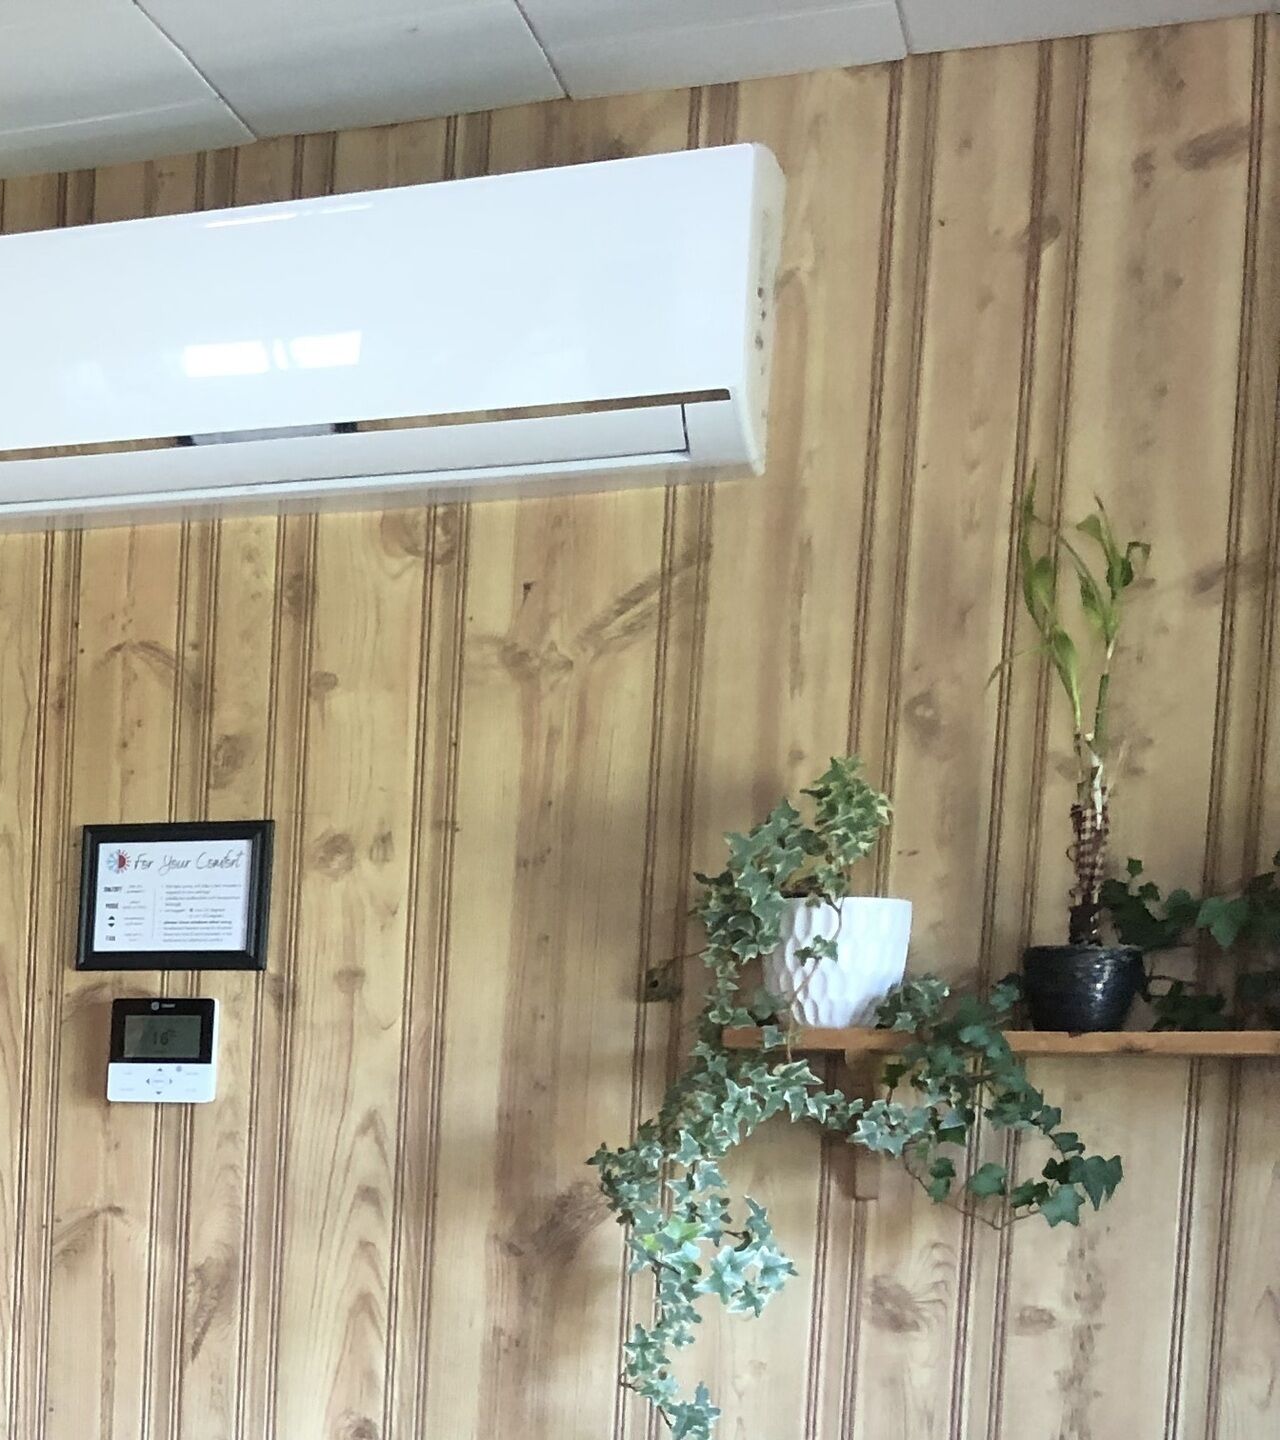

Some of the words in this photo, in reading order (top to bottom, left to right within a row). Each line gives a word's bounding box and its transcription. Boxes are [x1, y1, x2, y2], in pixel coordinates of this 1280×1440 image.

[133, 852, 154, 870] For
[158, 854, 192, 876] Your
[196, 849, 244, 870] Comfort
